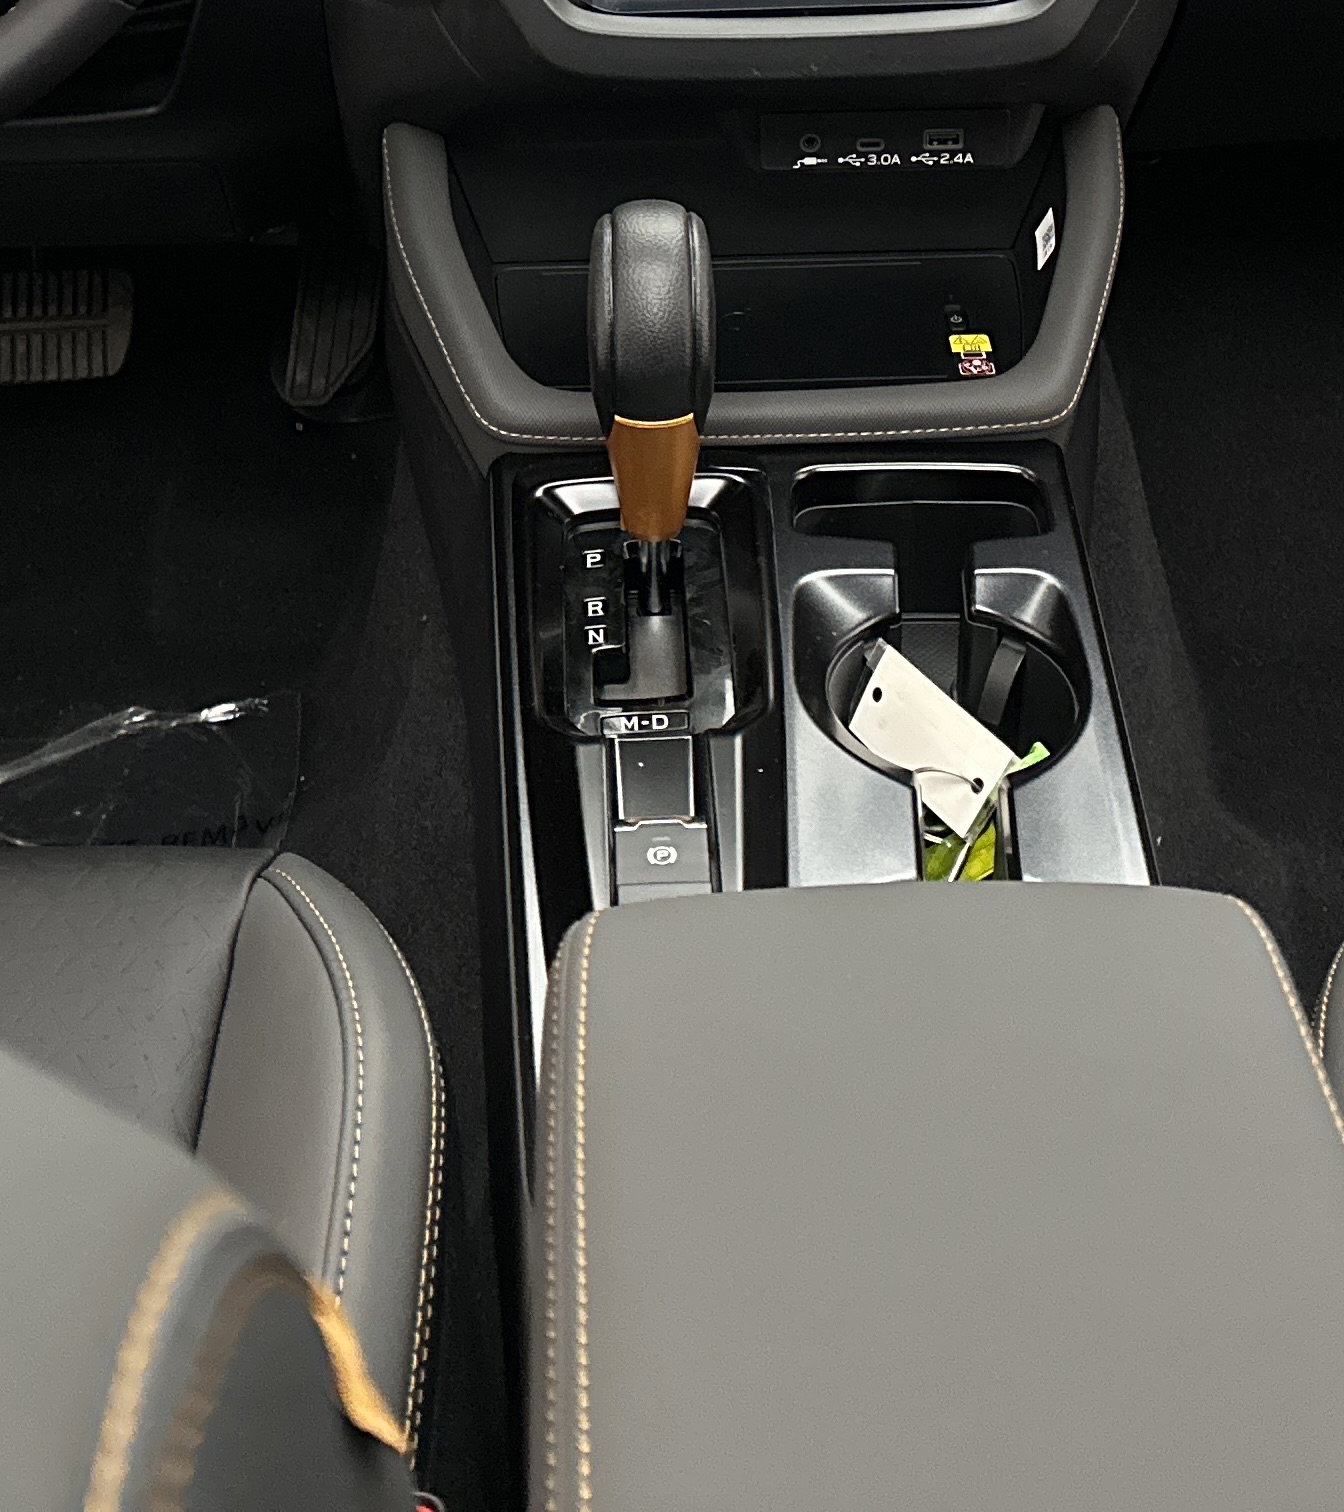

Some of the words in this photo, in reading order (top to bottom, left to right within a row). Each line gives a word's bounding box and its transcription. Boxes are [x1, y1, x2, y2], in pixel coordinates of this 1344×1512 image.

[867, 153, 901, 166] 3.0A
[939, 153, 974, 165] 2.4A
[586, 553, 603, 568] P
[587, 601, 605, 617] R
[587, 629, 605, 645] N
